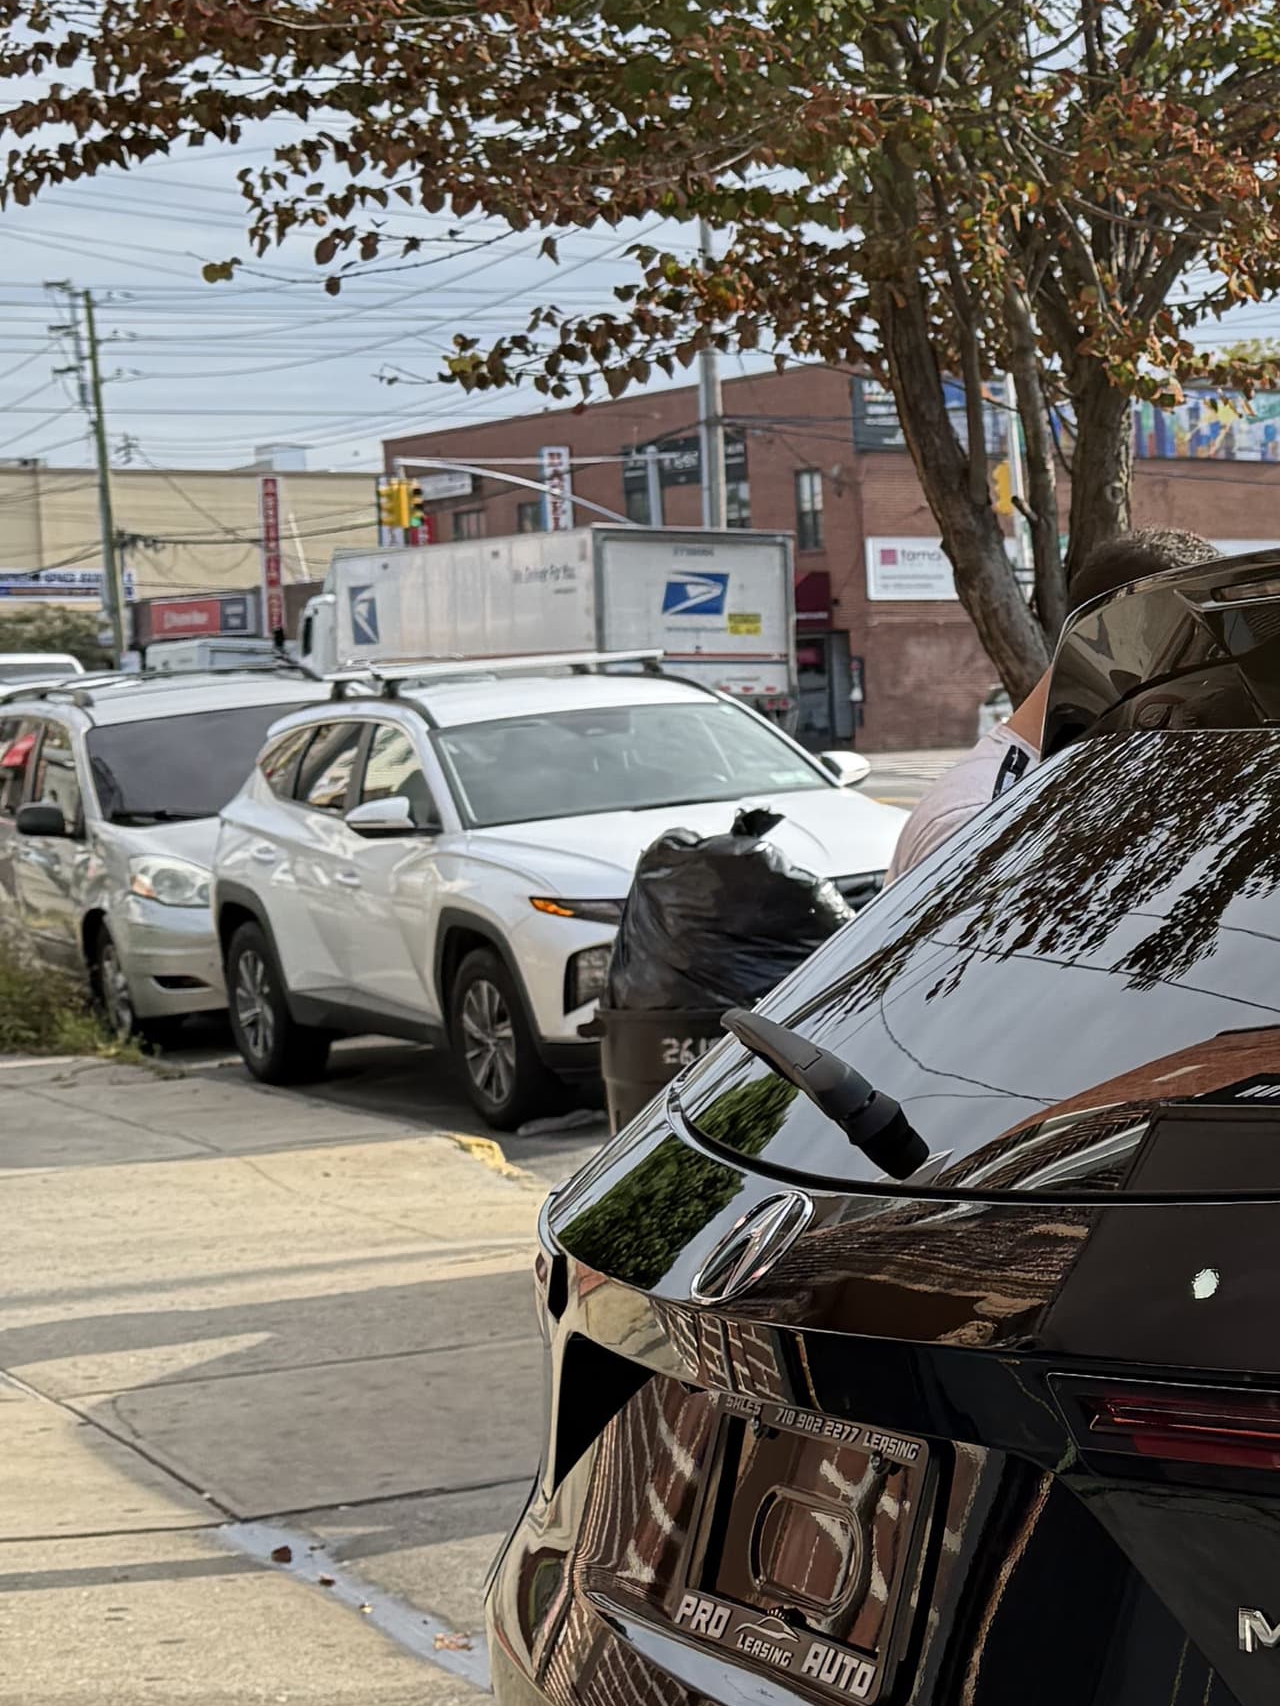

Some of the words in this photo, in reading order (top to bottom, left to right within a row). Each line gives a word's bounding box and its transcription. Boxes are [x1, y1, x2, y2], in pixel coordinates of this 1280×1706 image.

[797, 1411, 823, 1433] 902
[824, 1421, 860, 1442] 2277
[863, 1431, 922, 1460] LEASING
[674, 1594, 731, 1639] PRO
[801, 1643, 876, 1698] AUTO
[736, 1633, 794, 1668] LEASING
